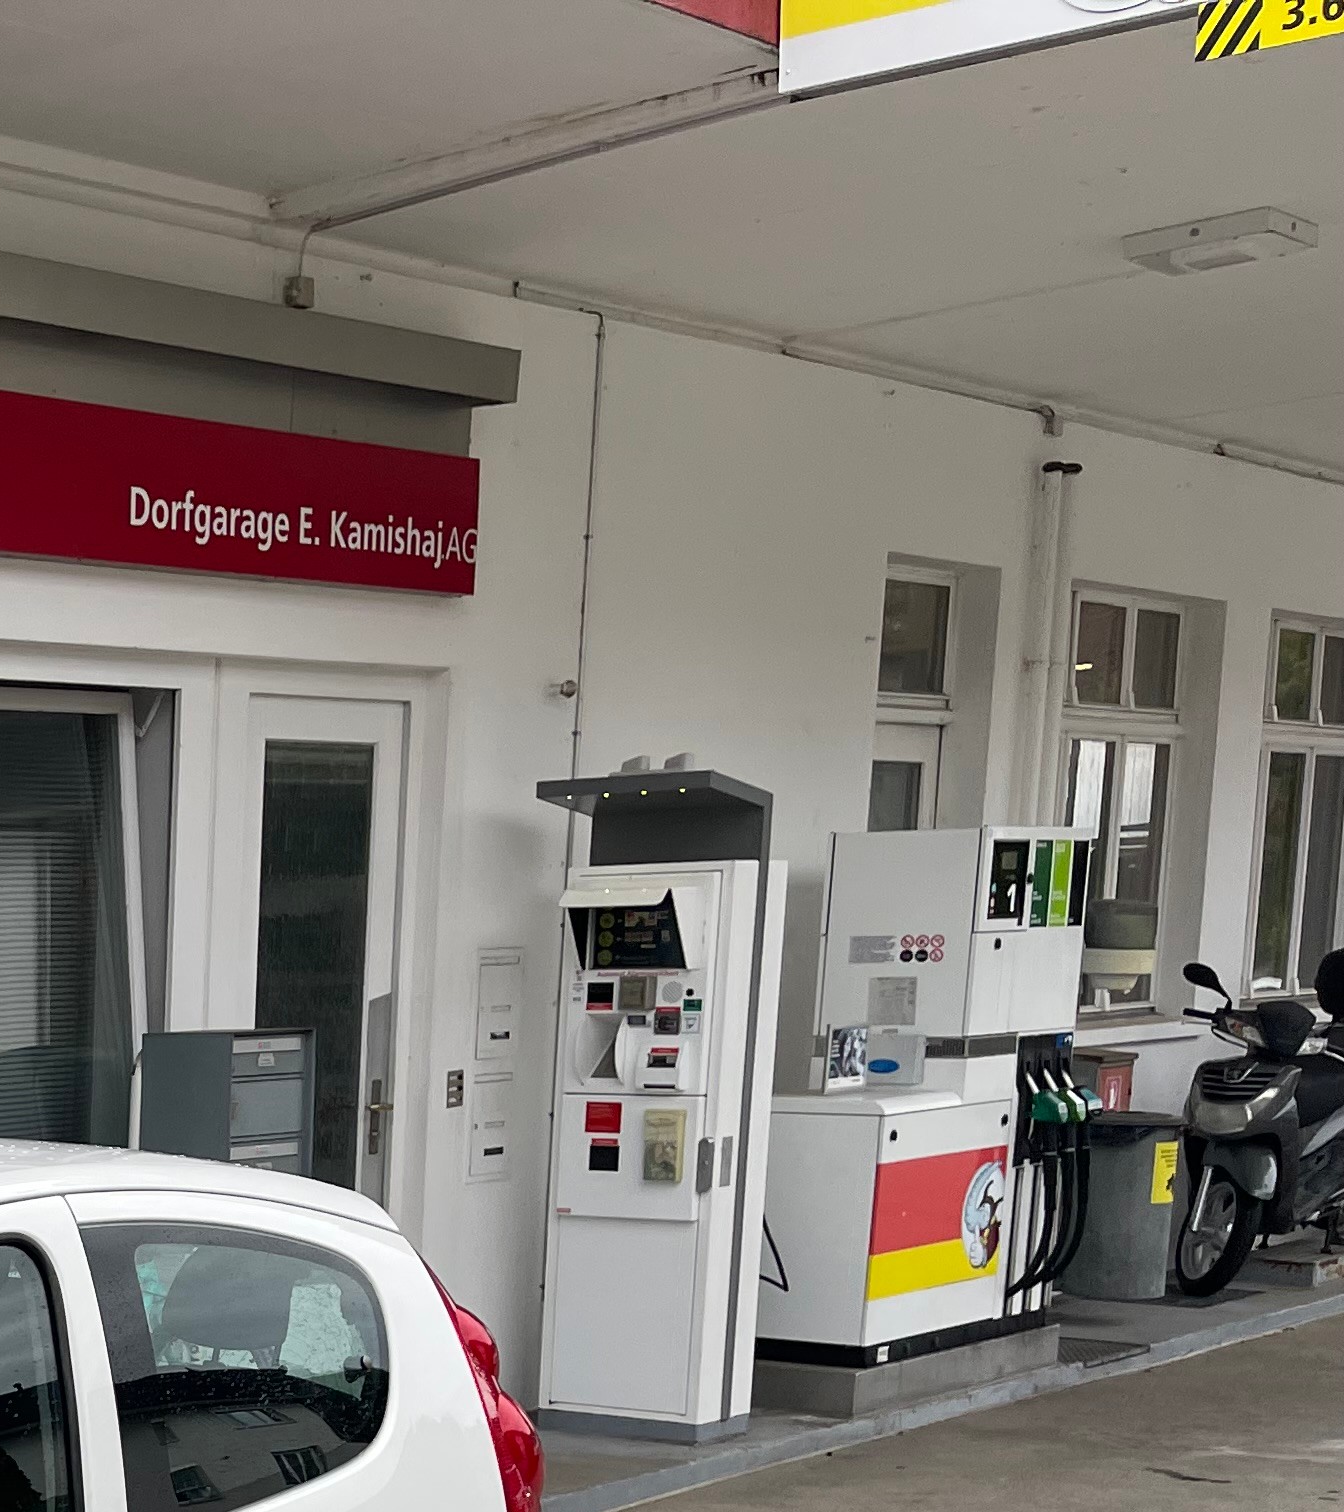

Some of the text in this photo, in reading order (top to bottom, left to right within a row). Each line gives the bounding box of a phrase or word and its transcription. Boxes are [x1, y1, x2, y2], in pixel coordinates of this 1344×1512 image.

[129, 486, 290, 551] Dorfgarage
[299, 507, 320, 546] E.
[1006, 883, 1017, 913] 1
